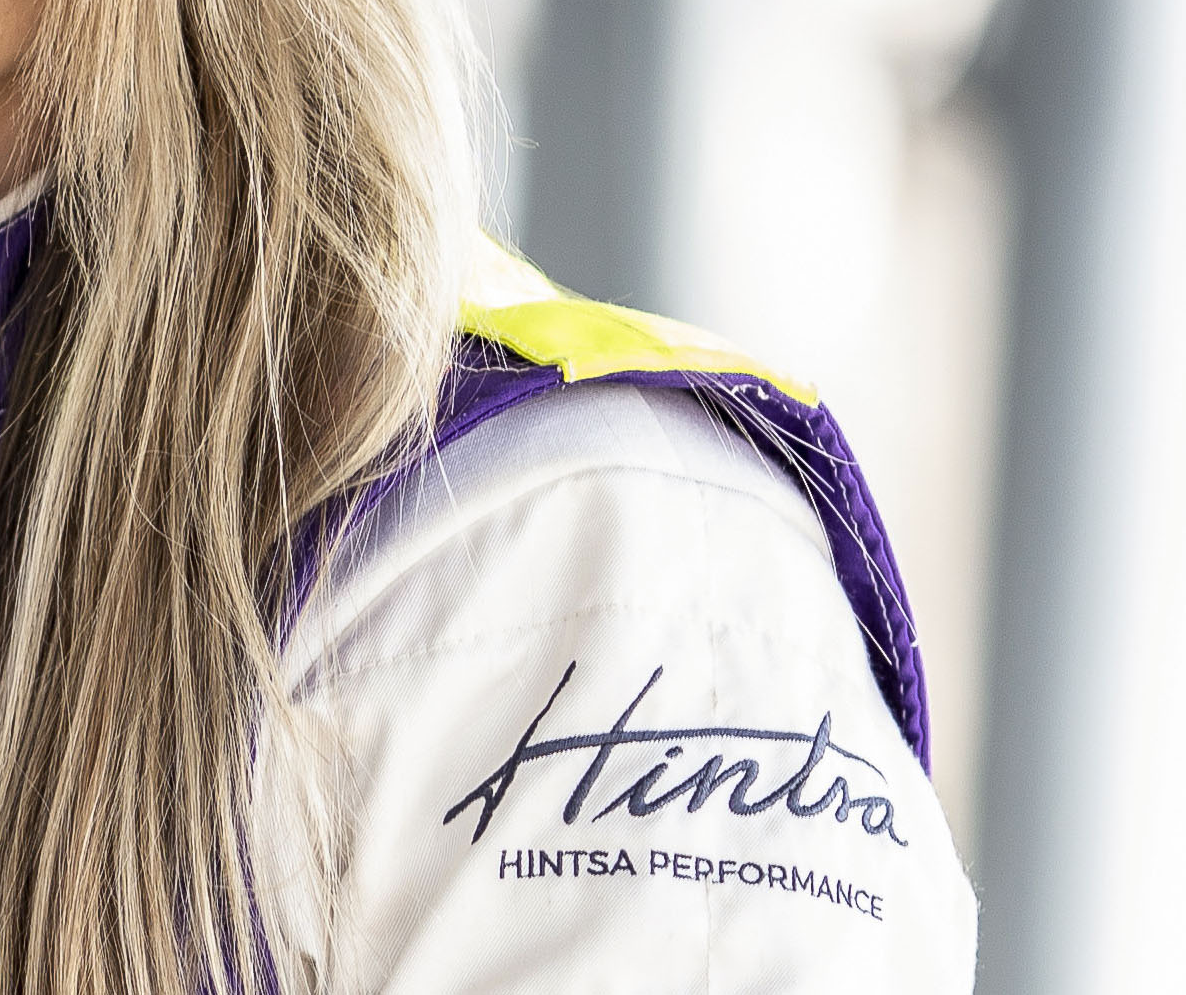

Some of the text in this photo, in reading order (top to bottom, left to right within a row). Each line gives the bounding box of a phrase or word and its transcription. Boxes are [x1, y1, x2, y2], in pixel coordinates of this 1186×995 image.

[443, 659, 908, 846] Hintsa
[499, 849, 884, 921] HINTSA PERFORMANCE
